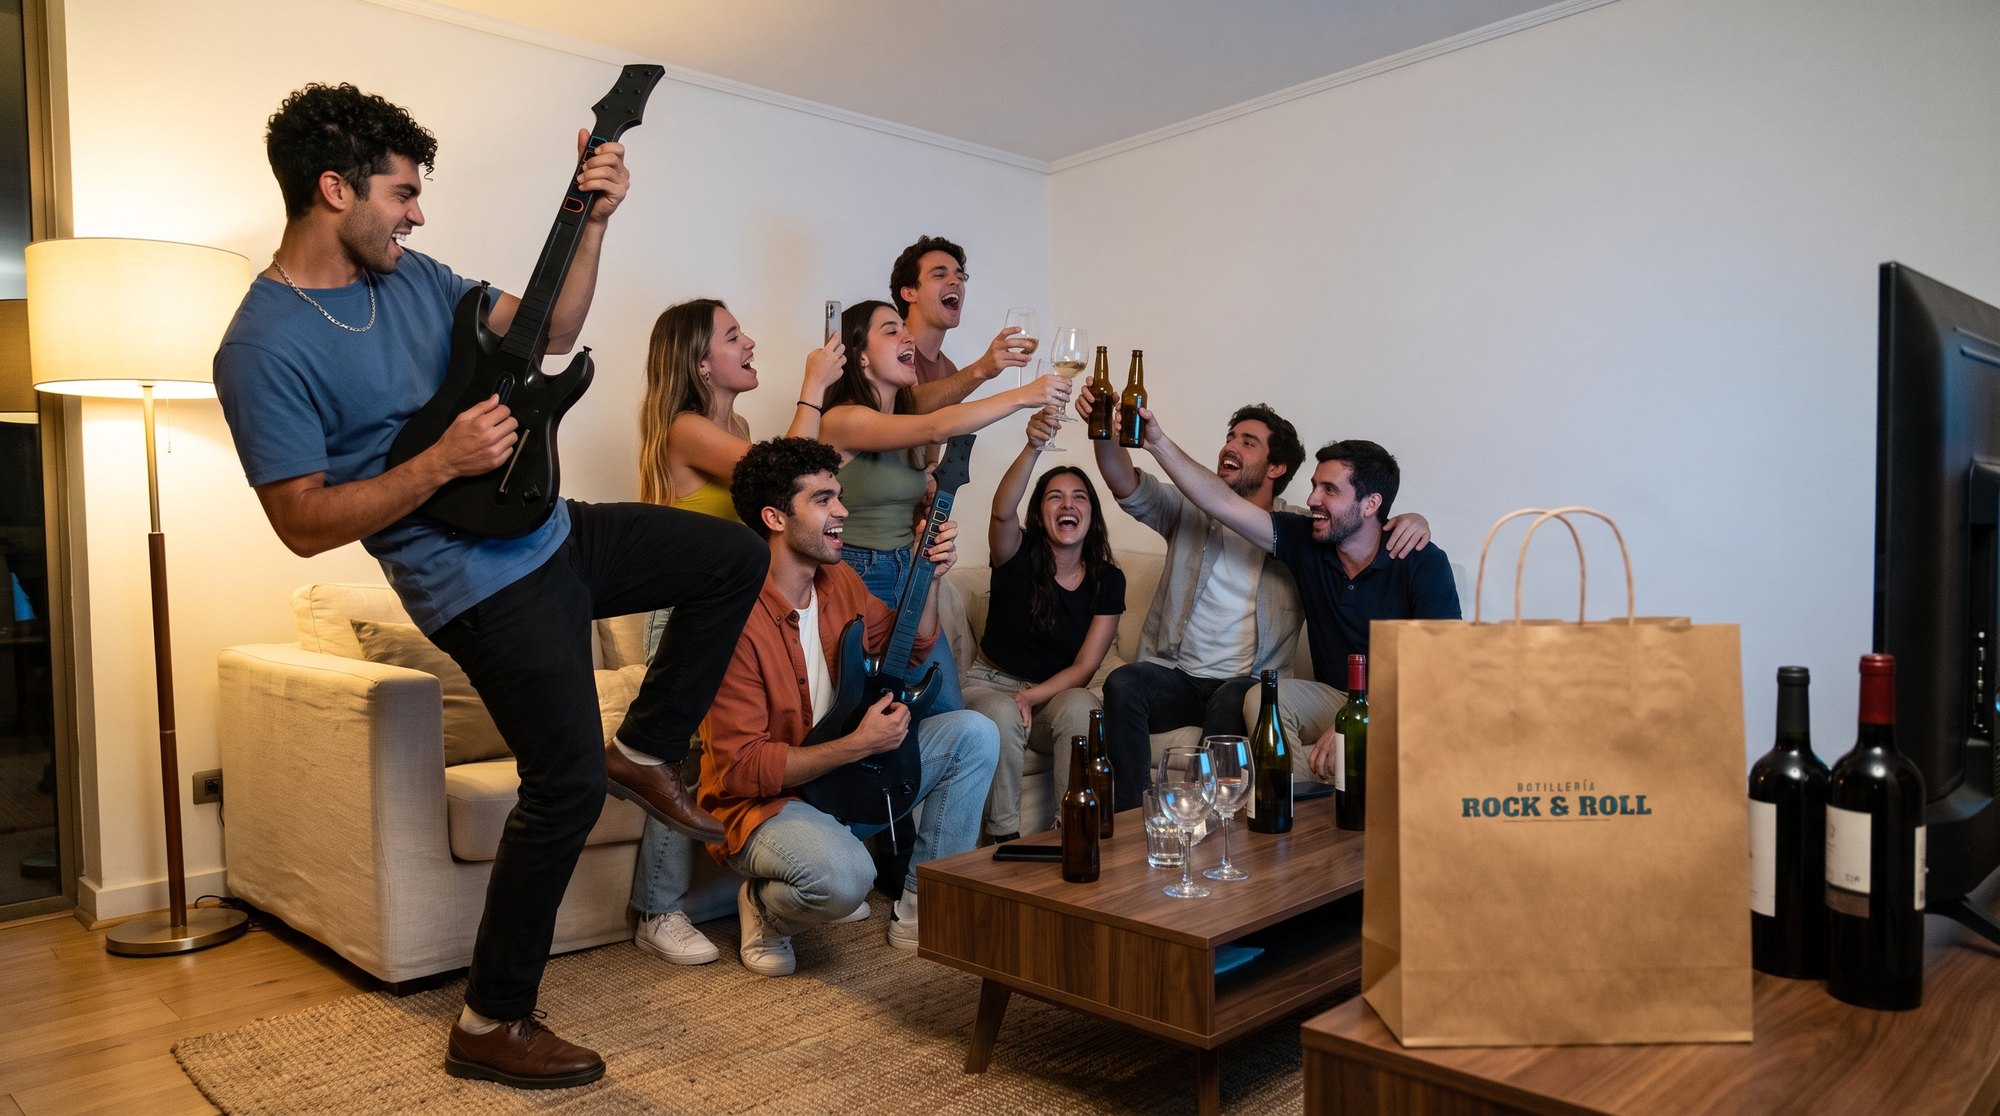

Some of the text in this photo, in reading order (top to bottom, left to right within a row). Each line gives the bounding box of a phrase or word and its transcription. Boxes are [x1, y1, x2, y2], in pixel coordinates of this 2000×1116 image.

[1517, 779, 1595, 792] BOTILLERÍA
[1462, 795, 1652, 817] ROCK & ROLL
